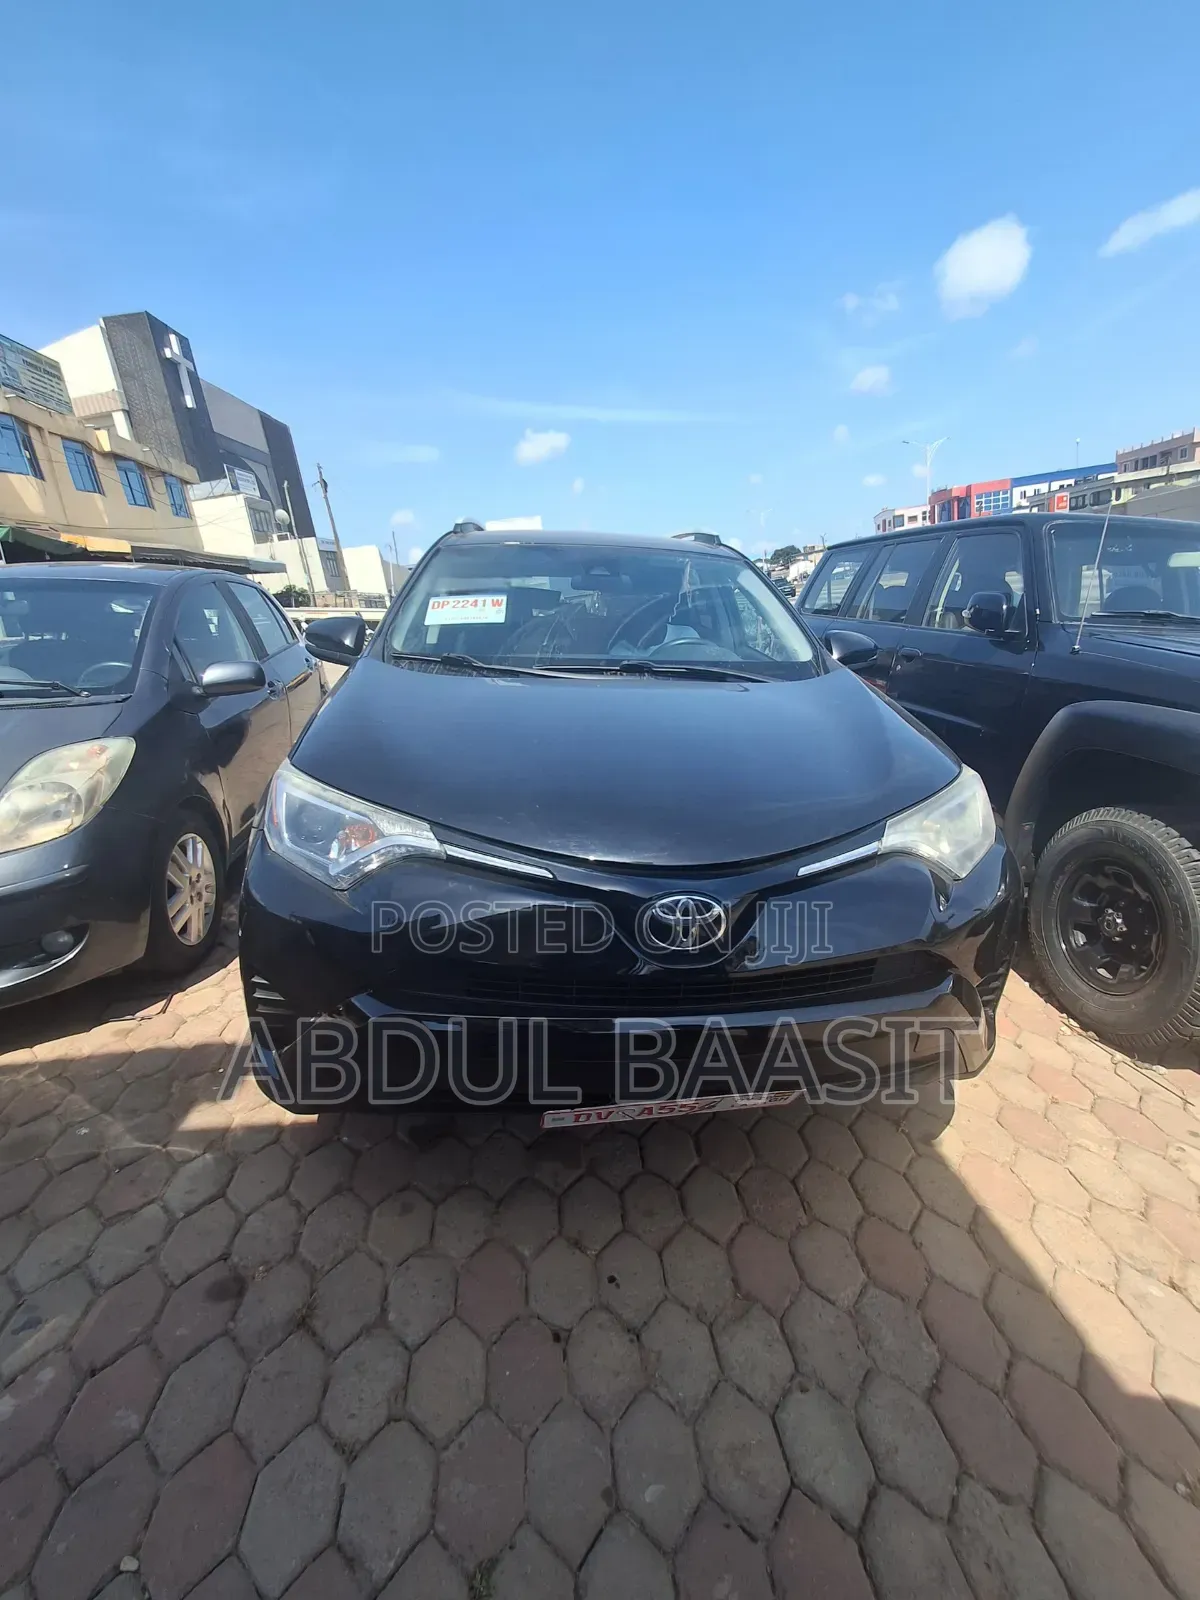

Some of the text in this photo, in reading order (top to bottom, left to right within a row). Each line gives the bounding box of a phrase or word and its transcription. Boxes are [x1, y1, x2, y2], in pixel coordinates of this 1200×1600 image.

[431, 598, 504, 610] DP 2241 W
[573, 1110, 615, 1123] DV
